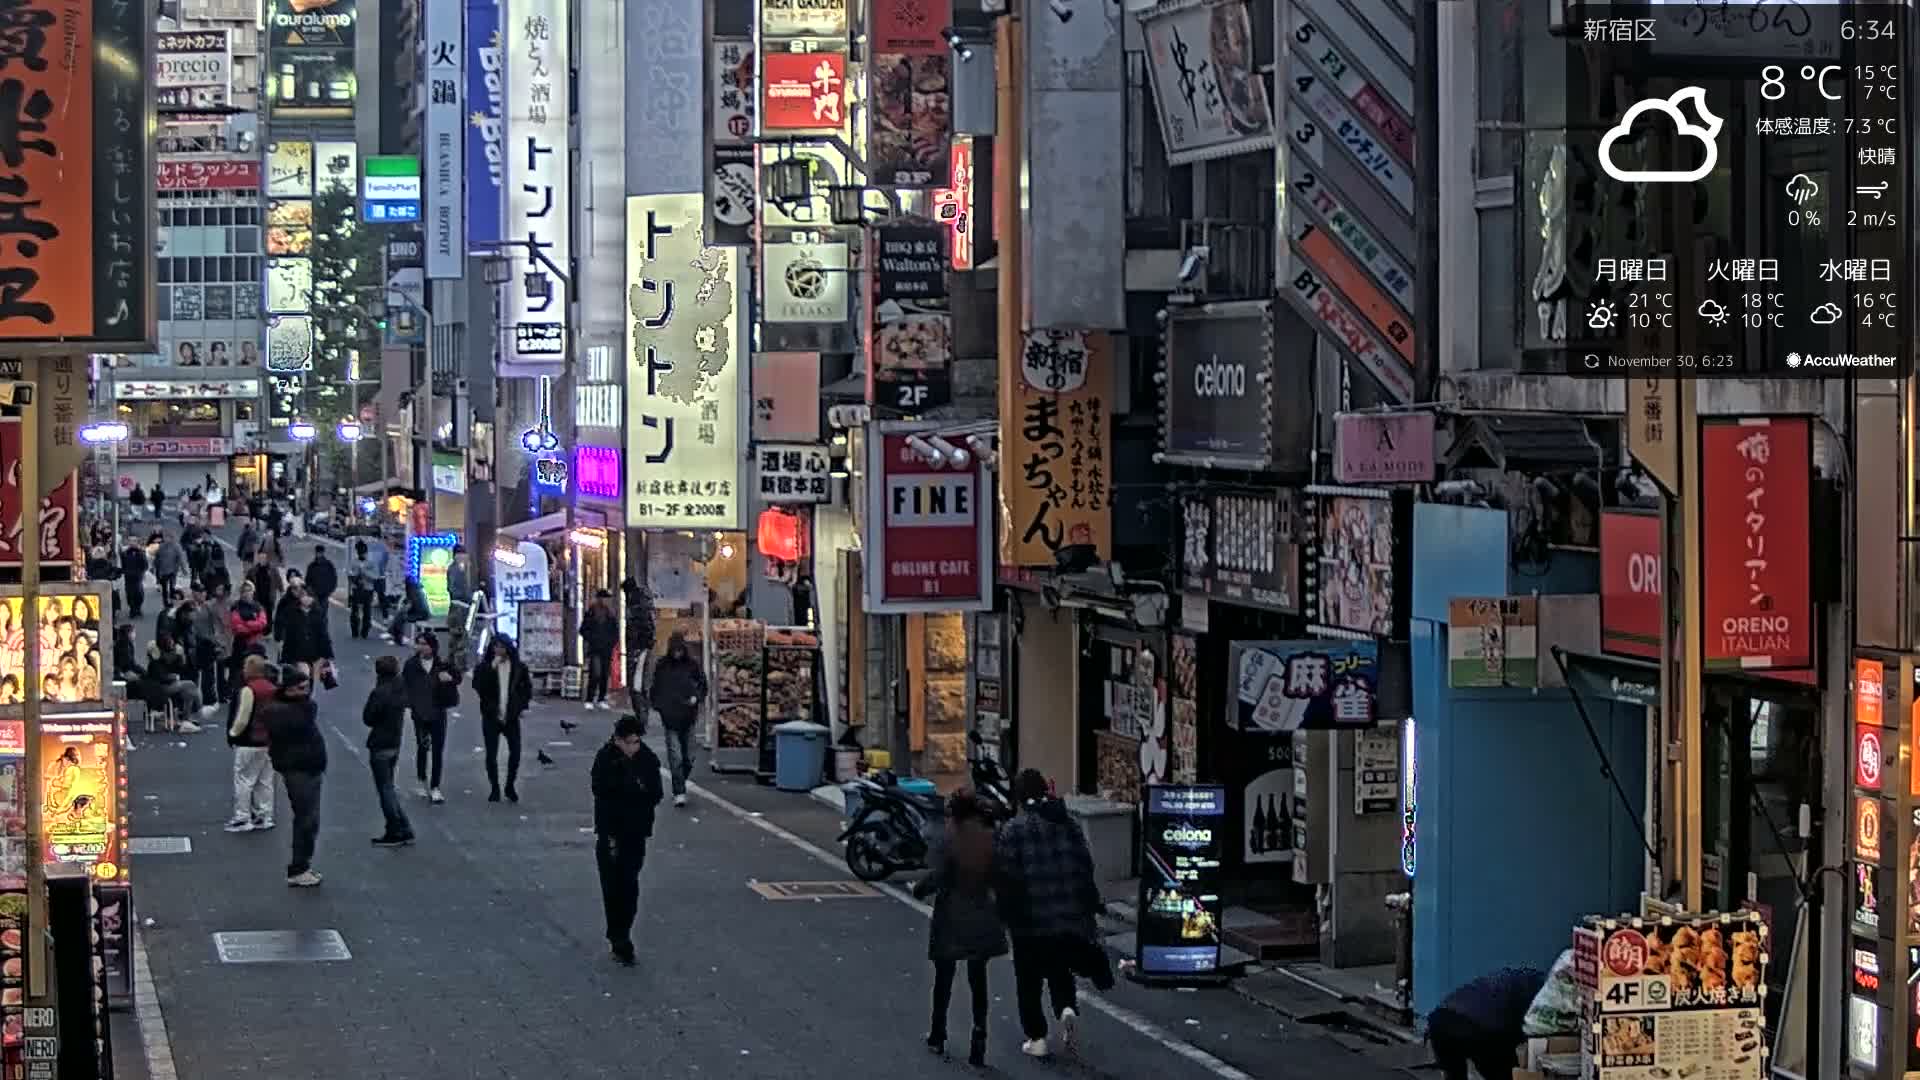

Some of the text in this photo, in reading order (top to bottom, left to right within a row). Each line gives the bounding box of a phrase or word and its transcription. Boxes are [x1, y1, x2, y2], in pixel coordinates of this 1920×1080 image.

[1296, 23, 1316, 43] 5
[432, 40, 456, 105] 火鍋
[812, 60, 841, 122] 牛門
[1296, 75, 1315, 92] 4
[1296, 123, 1315, 144] 3
[368, 183, 417, 193] FamilyMart
[1295, 173, 1315, 196] 2
[882, 256, 941, 273] Walton's
[642, 210, 673, 463] トントン
[1194, 353, 1246, 398] celona
[898, 387, 929, 407] 2F
[761, 451, 825, 473] 酒場心
[1023, 397, 1066, 550] まっちゃん
[761, 475, 826, 495] 新宿本店
[892, 485, 969, 515] FINE
[1735, 432, 1770, 605] 俺のイタリアン
[892, 560, 970, 577] ONLINE CAFE
[1722, 616, 1789, 633] ORENO
[1721, 637, 1790, 650] ITALIAN
[1332, 656, 1374, 673] フリー
[1162, 829, 1213, 846] celona
[1606, 982, 1639, 1005] 4F
[24, 1008, 54, 1027] NERO
[26, 1039, 56, 1057] NERO
